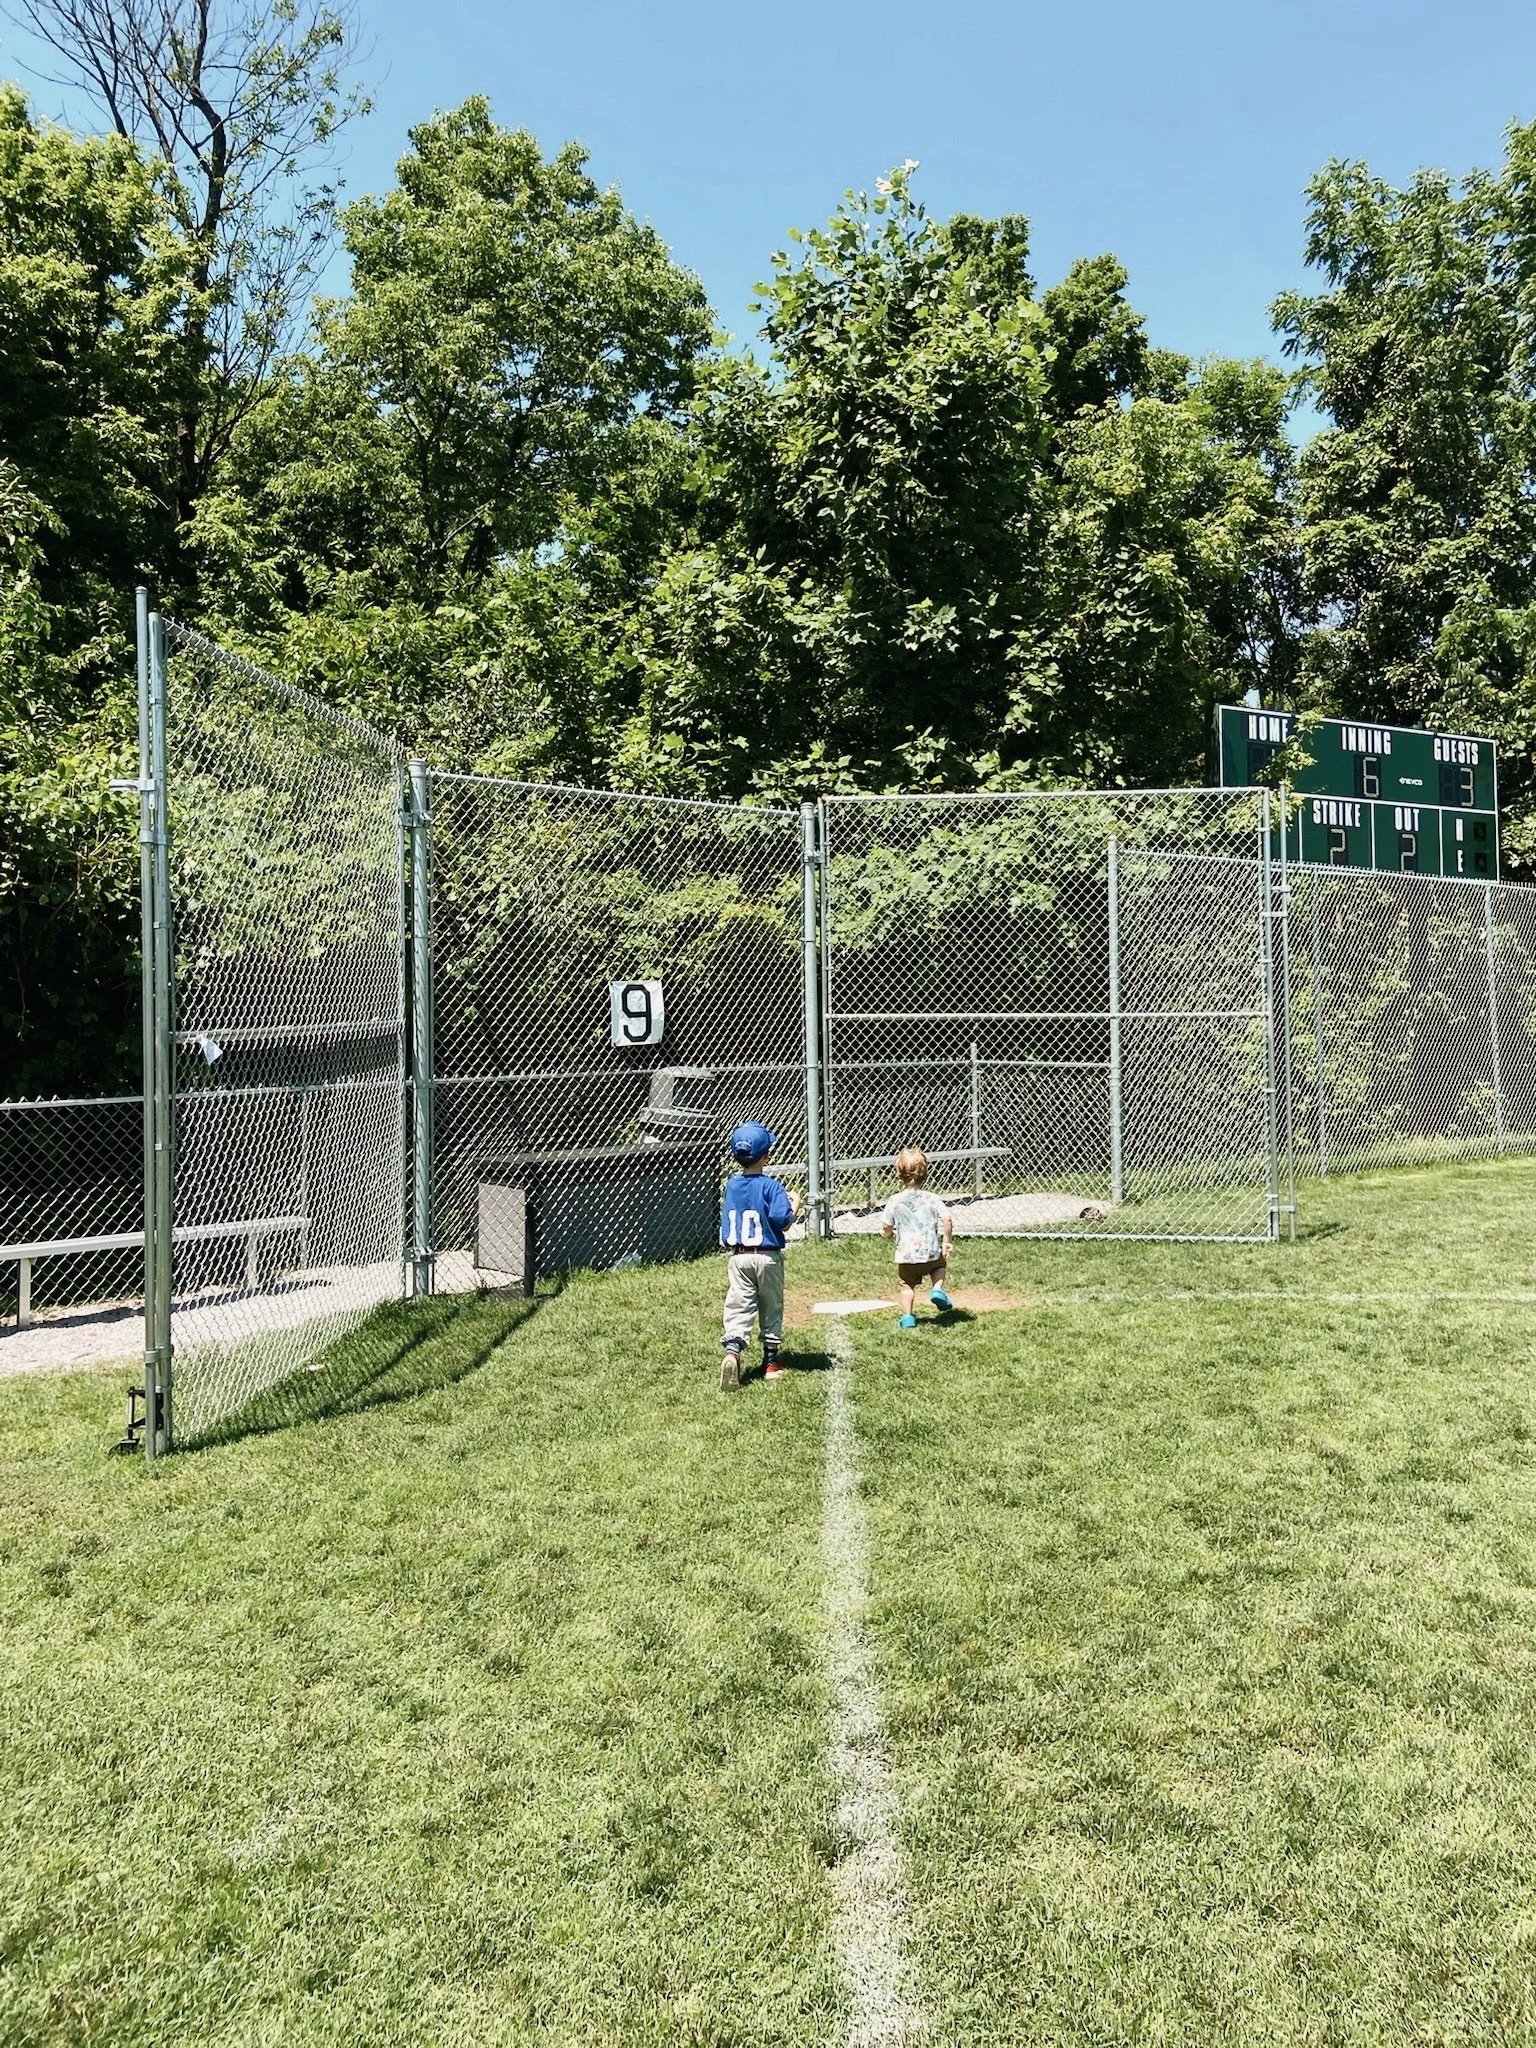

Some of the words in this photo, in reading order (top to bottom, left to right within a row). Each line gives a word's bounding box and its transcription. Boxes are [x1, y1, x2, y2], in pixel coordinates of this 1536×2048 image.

[1248, 714, 1288, 743] HOME
[1341, 726, 1392, 755] INNING
[1433, 738, 1479, 766] GUESTS
[1362, 756, 1380, 798] 6
[1460, 767, 1475, 807] 3
[1312, 799, 1361, 827] STRIKE
[1394, 806, 1420, 832] OUT
[1400, 833, 1416, 873] 2
[1456, 849, 1464, 873] E
[621, 984, 651, 1043] 9
[726, 1209, 763, 1247] 10
